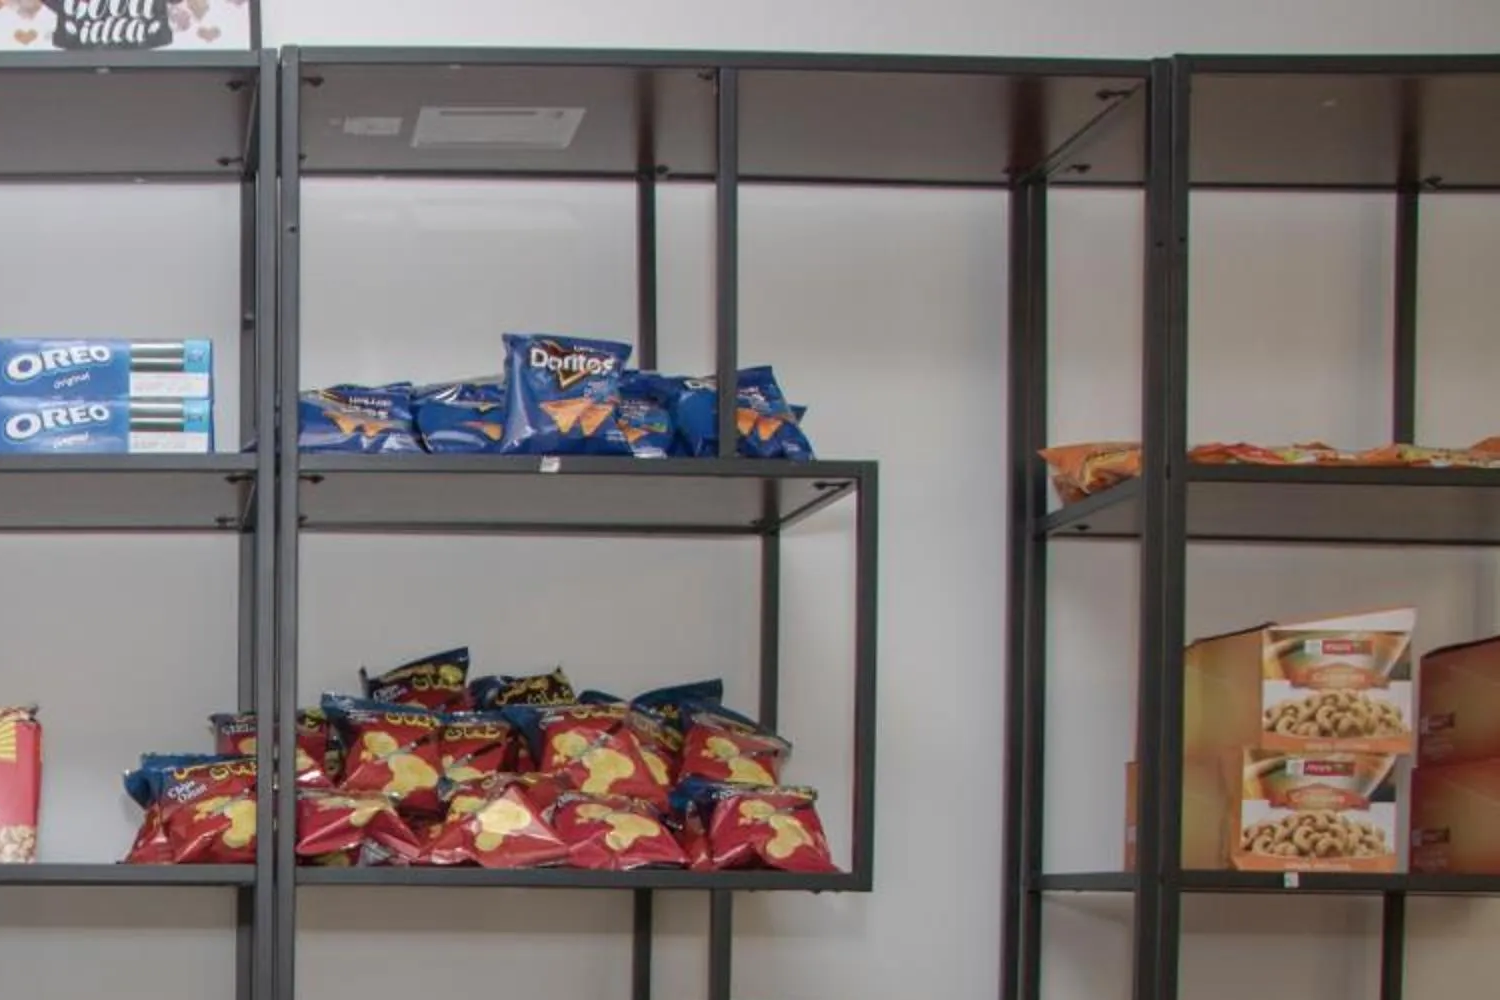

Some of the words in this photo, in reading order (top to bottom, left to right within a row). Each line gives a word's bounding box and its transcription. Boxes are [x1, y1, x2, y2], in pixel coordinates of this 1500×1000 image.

[6, 344, 111, 381] OREO
[530, 347, 616, 376] Doritos
[53, 371, 91, 390] original
[4, 402, 110, 440] OREO
